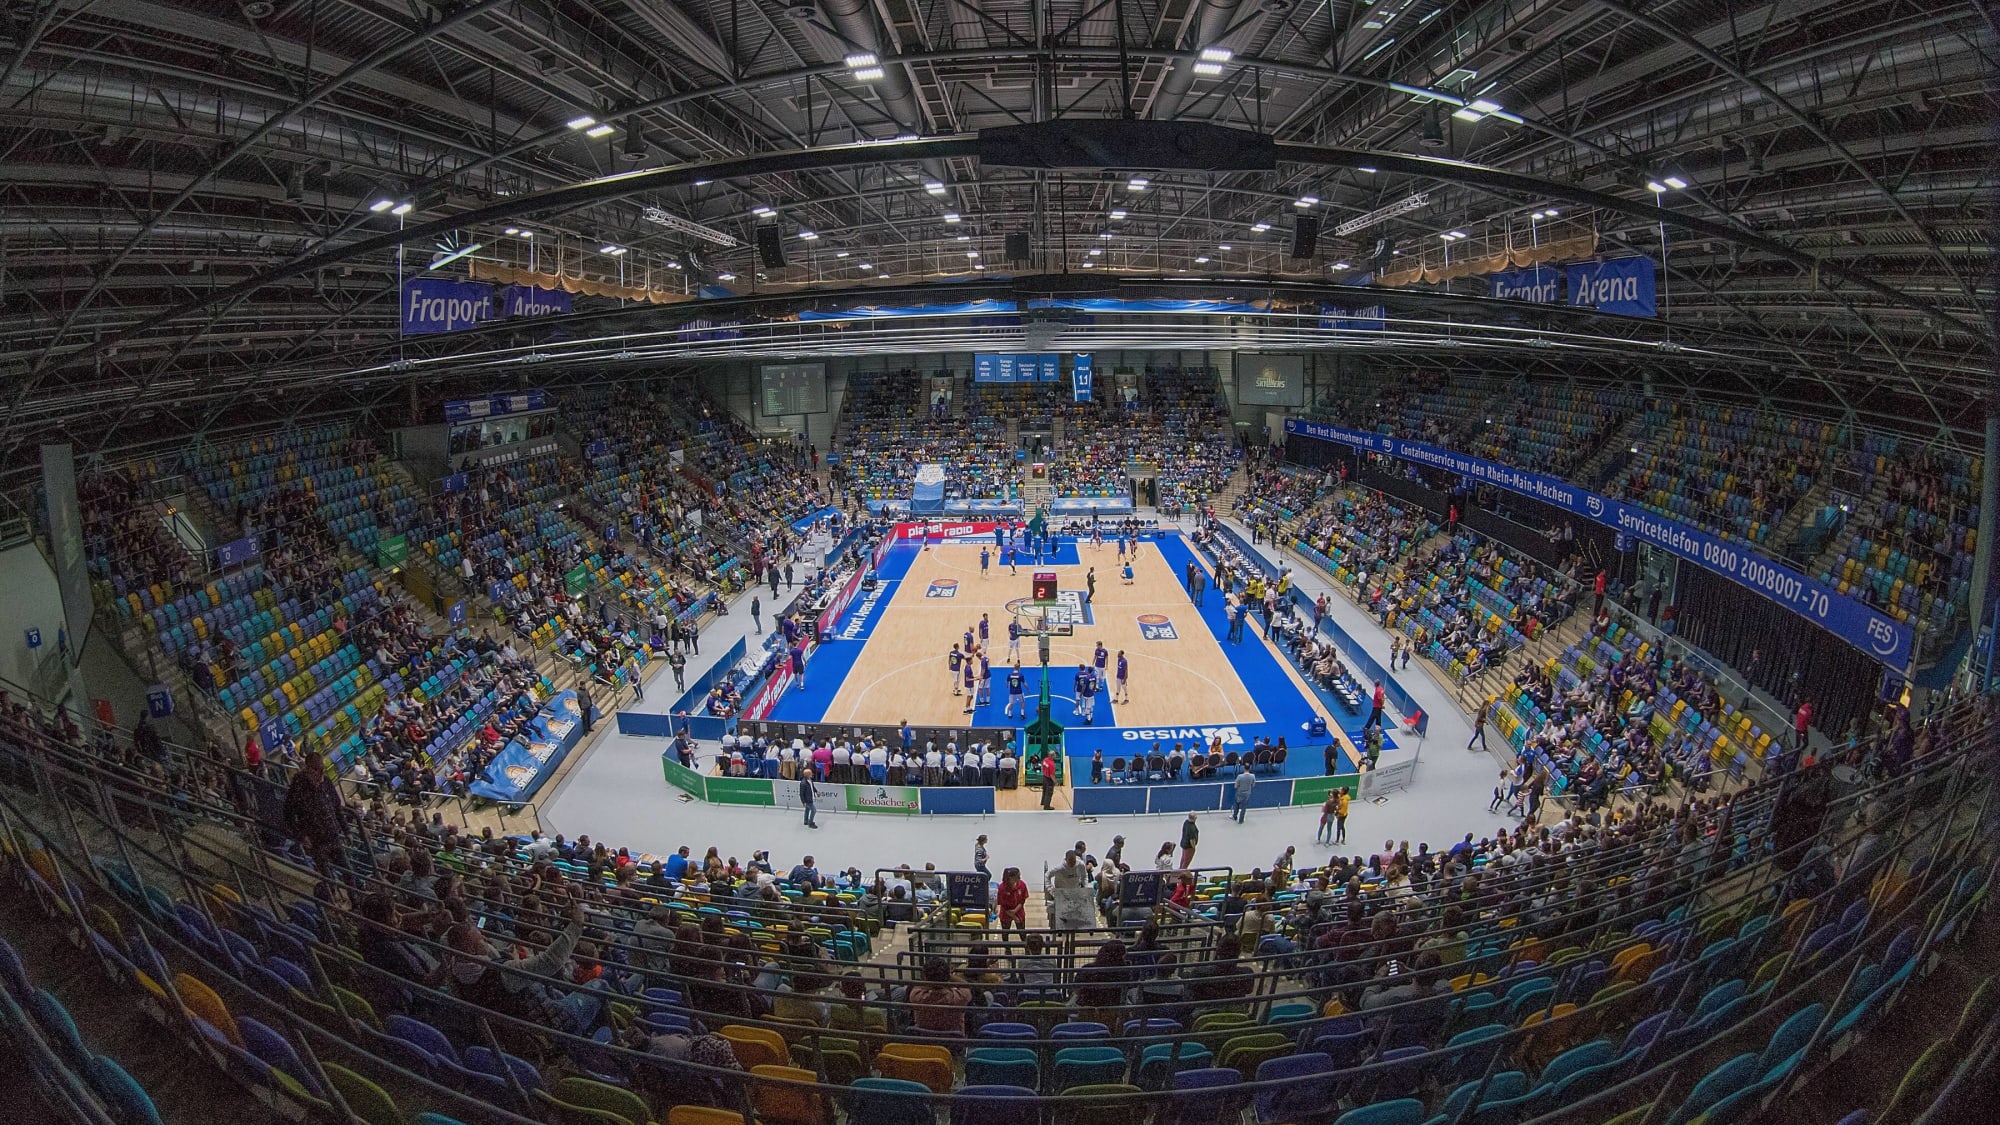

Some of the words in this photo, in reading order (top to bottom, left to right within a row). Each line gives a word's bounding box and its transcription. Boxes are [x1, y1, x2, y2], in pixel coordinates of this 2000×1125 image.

[1576, 273, 1638, 305] Arena
[408, 290, 490, 330] Fraport
[1079, 374, 1088, 385] 11
[1306, 425, 1316, 434] Den
[1317, 427, 1329, 437] Rest
[1330, 428, 1363, 445] übernehmen
[1364, 437, 1374, 447] wir
[1400, 443, 1455, 468] Containerservice
[1456, 460, 1469, 472] von
[1471, 462, 1485, 476] den
[1487, 465, 1573, 506] Rhein-Main-Machern
[1586, 495, 1601, 510] FES
[1617, 508, 1700, 556] Servicetelefon
[1703, 542, 1737, 572] 0800
[1740, 557, 1829, 618] 2008007-70
[1037, 587, 1045, 598] 2
[1867, 617, 1893, 643] FES
[859, 797, 905, 807] Rosbacher
[954, 875, 980, 883] Block
[1128, 873, 1154, 883] Block
[964, 884, 974, 897] L
[1136, 883, 1145, 896] L
